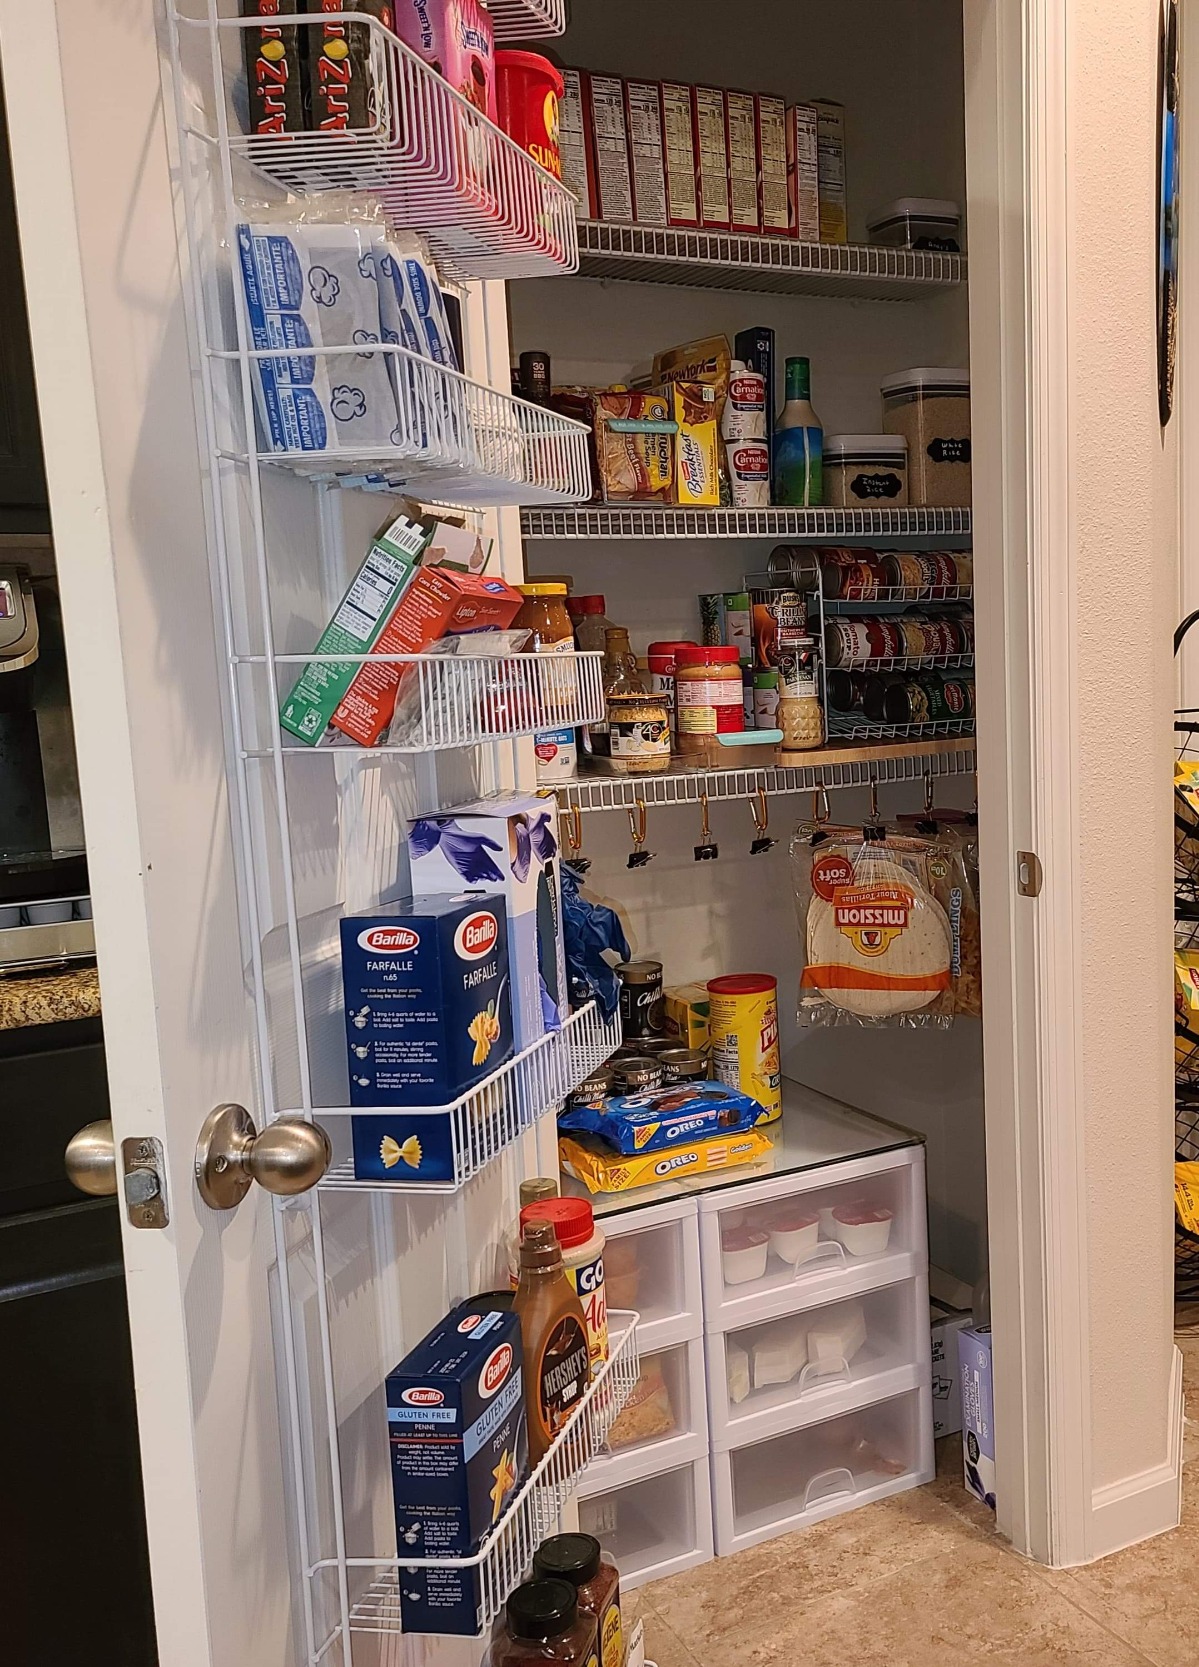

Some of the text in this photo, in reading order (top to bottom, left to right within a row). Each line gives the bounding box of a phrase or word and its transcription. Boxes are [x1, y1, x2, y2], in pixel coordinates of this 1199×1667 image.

[533, 362, 545, 371] 30
[680, 429, 703, 498] Breakfast
[372, 548, 405, 572] Nutrition Facts
[361, 572, 378, 586] Calories
[418, 577, 452, 601] Corn Chowder
[456, 605, 477, 619] Lipton
[842, 627, 851, 651] SOUP
[818, 868, 847, 880] soft
[371, 933, 414, 946] Barilla
[465, 918, 495, 948] Barilla
[366, 961, 413, 971] FARFALLE
[463, 961, 497, 991] FARFALLE
[584, 1082, 606, 1091] BEANS
[637, 1074, 648, 1082] NO
[666, 1119, 704, 1139] OREO
[655, 1153, 698, 1175] OREO
[612, 1166, 628, 1187] FAMILY
[487, 1349, 510, 1387] Barilla
[543, 1346, 588, 1398] HERSHEY'S
[411, 1392, 441, 1401] Barilla
[562, 1380, 578, 1403] SYRUP
[397, 1409, 451, 1419] GLUTEN FREE
[476, 1376, 519, 1436] GLUTEN FREE
[493, 1422, 510, 1452] PENNE
